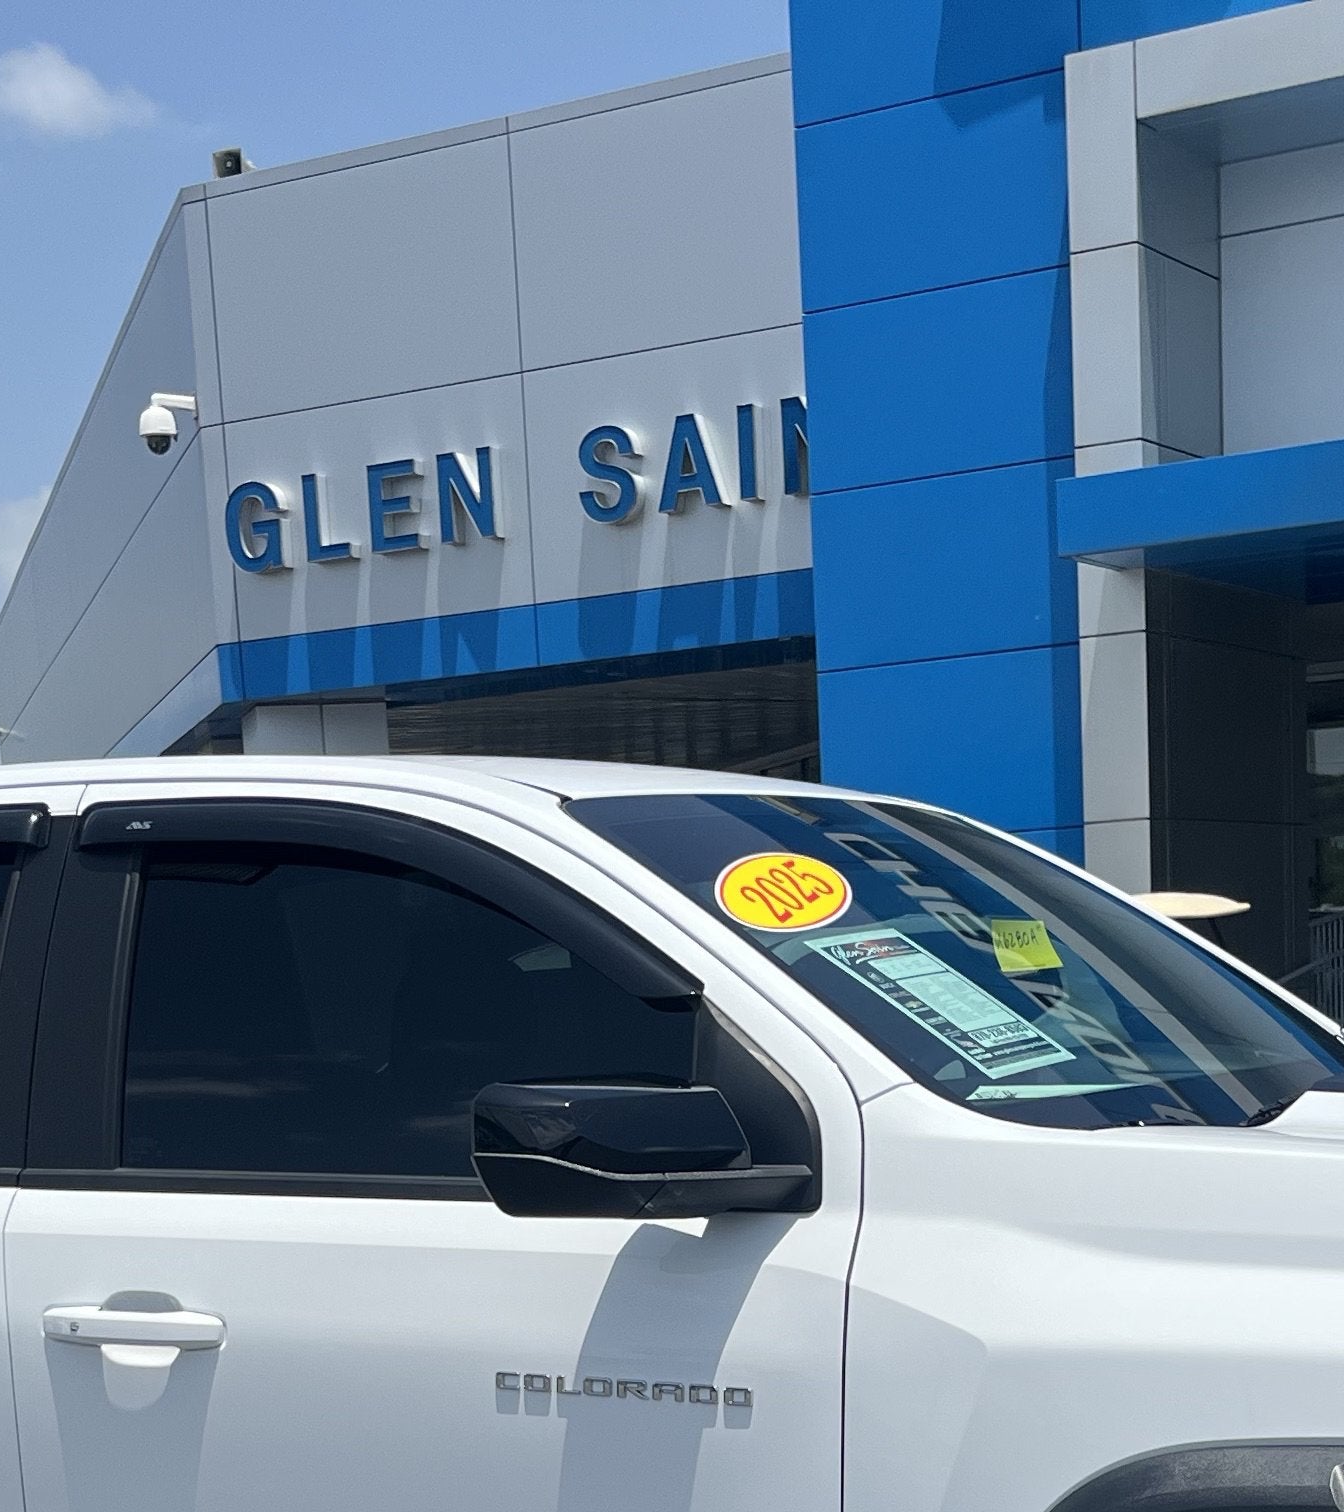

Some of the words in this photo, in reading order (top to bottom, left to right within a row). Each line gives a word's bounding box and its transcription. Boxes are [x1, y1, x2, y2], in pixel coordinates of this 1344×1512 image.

[225, 446, 504, 575] GLEN
[740, 860, 835, 923] 2025
[496, 1371, 753, 1408] COLORADO
